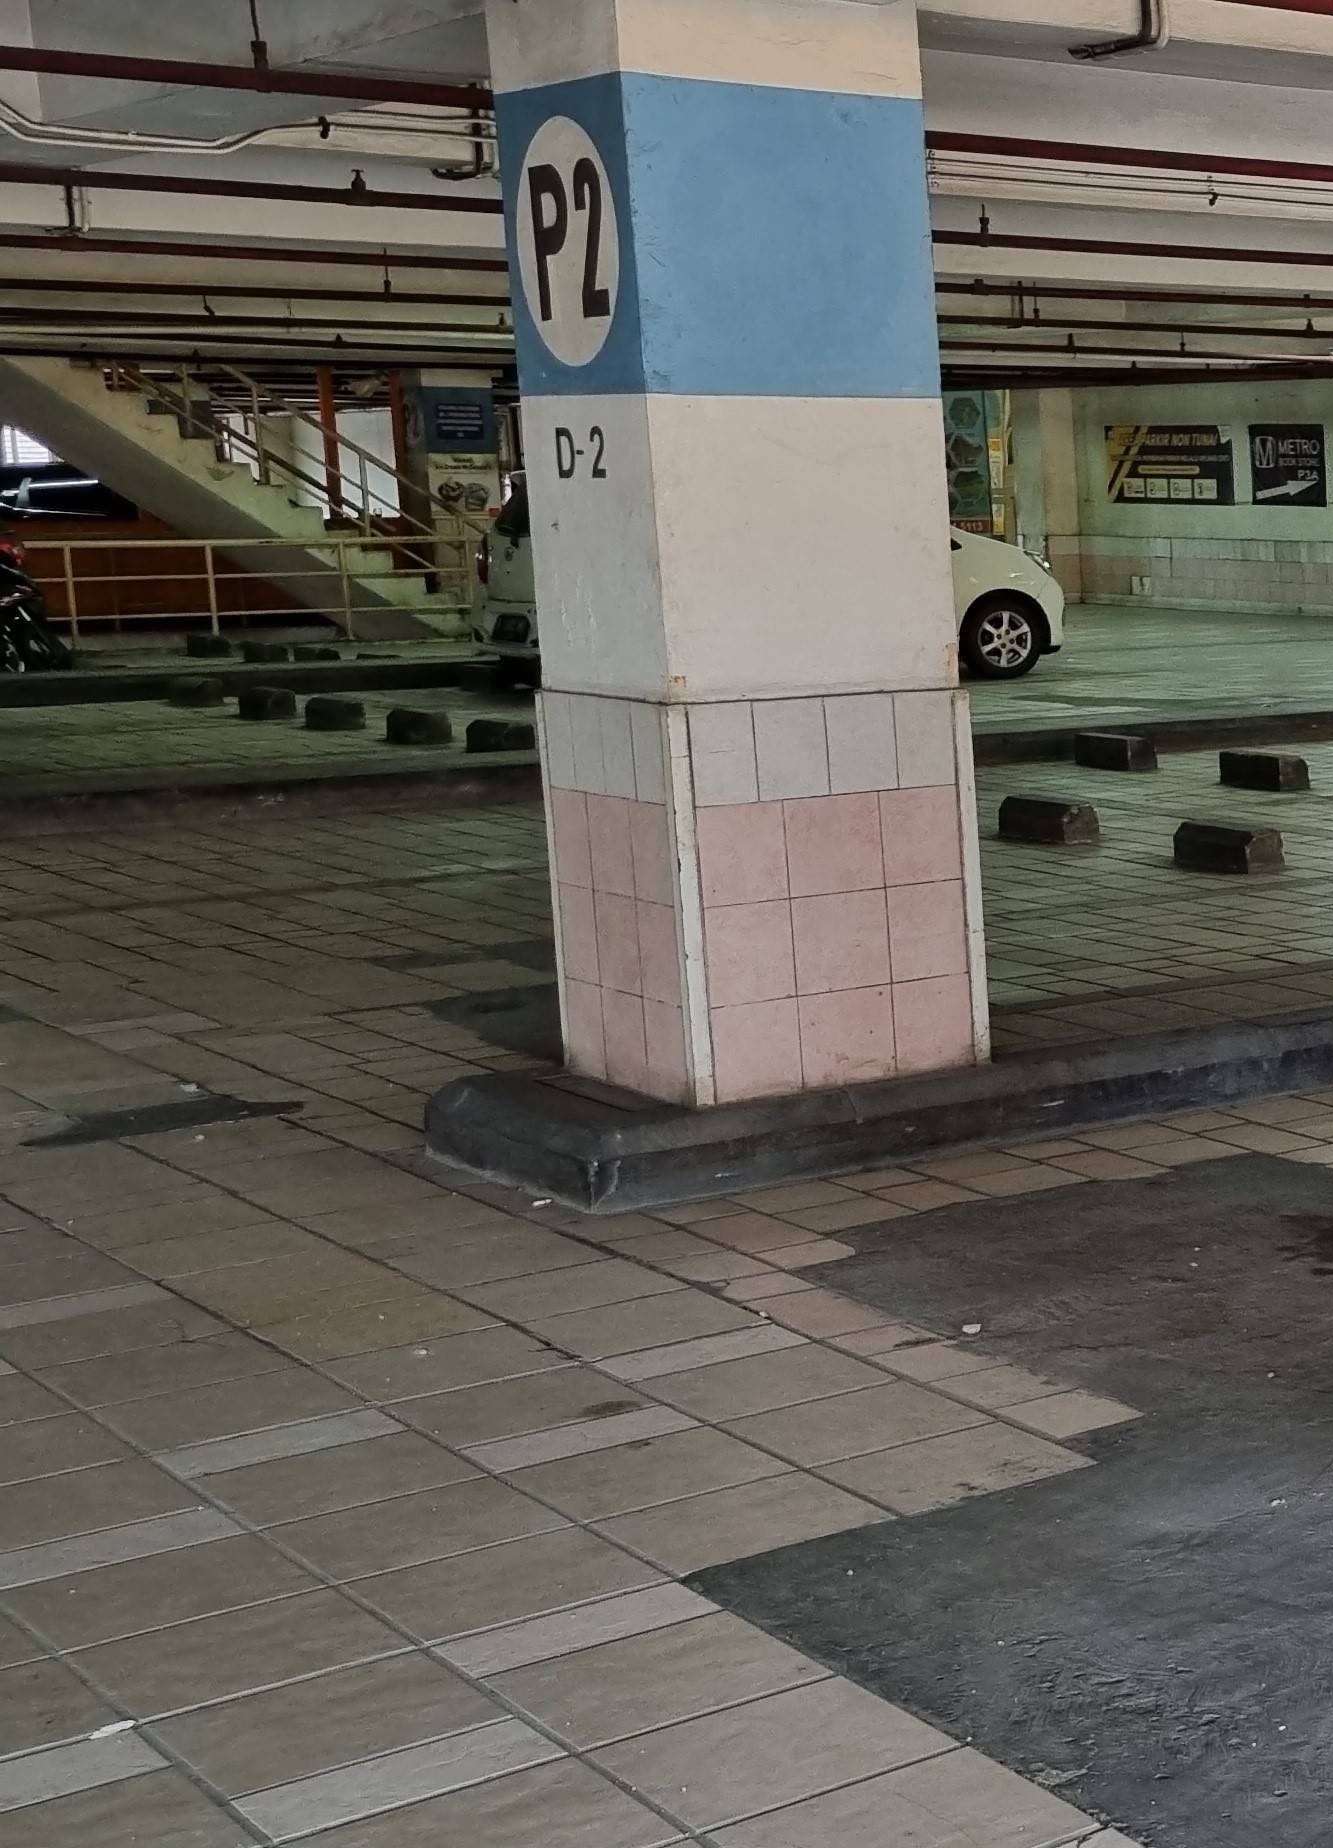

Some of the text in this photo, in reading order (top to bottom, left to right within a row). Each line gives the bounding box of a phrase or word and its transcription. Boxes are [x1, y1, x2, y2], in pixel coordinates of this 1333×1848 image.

[528, 157, 611, 321] P2
[555, 426, 608, 480] D-2
[1278, 439, 1320, 455] METRO
